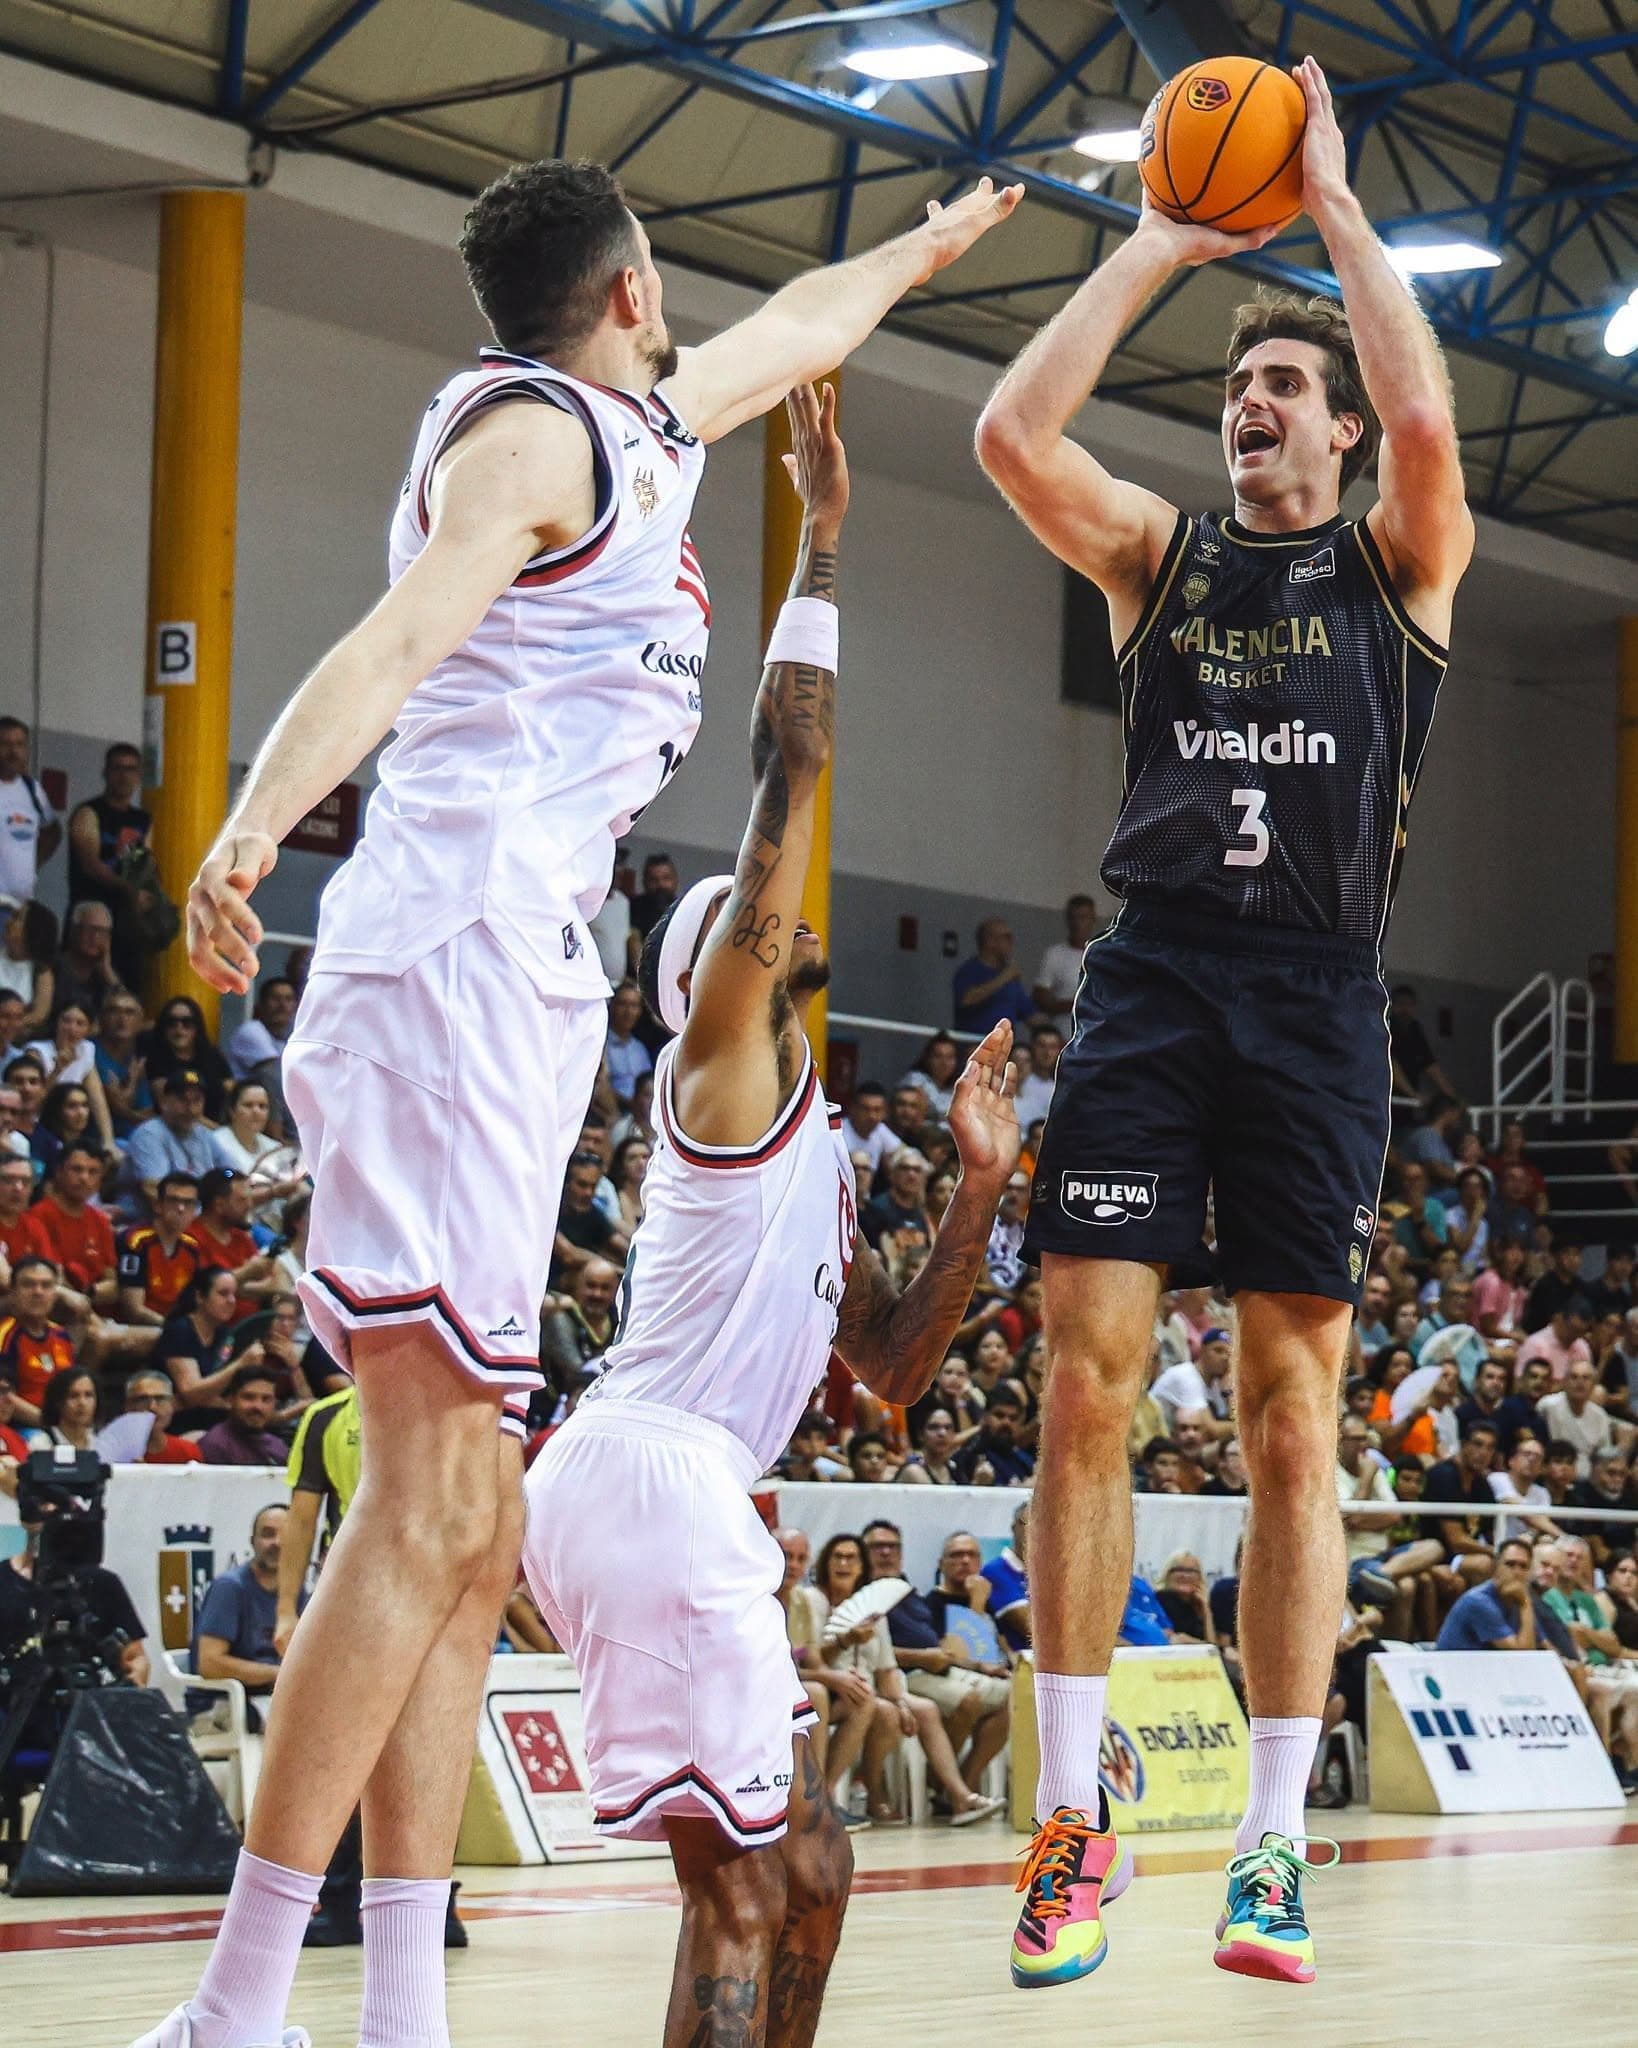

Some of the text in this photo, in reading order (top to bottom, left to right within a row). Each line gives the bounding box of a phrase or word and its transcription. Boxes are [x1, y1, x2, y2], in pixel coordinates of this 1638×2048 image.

[160, 629, 191, 674] B
[1198, 661, 1286, 689] BASKET
[1223, 789, 1270, 867] 3
[1067, 1181, 1150, 1204] PULEVA
